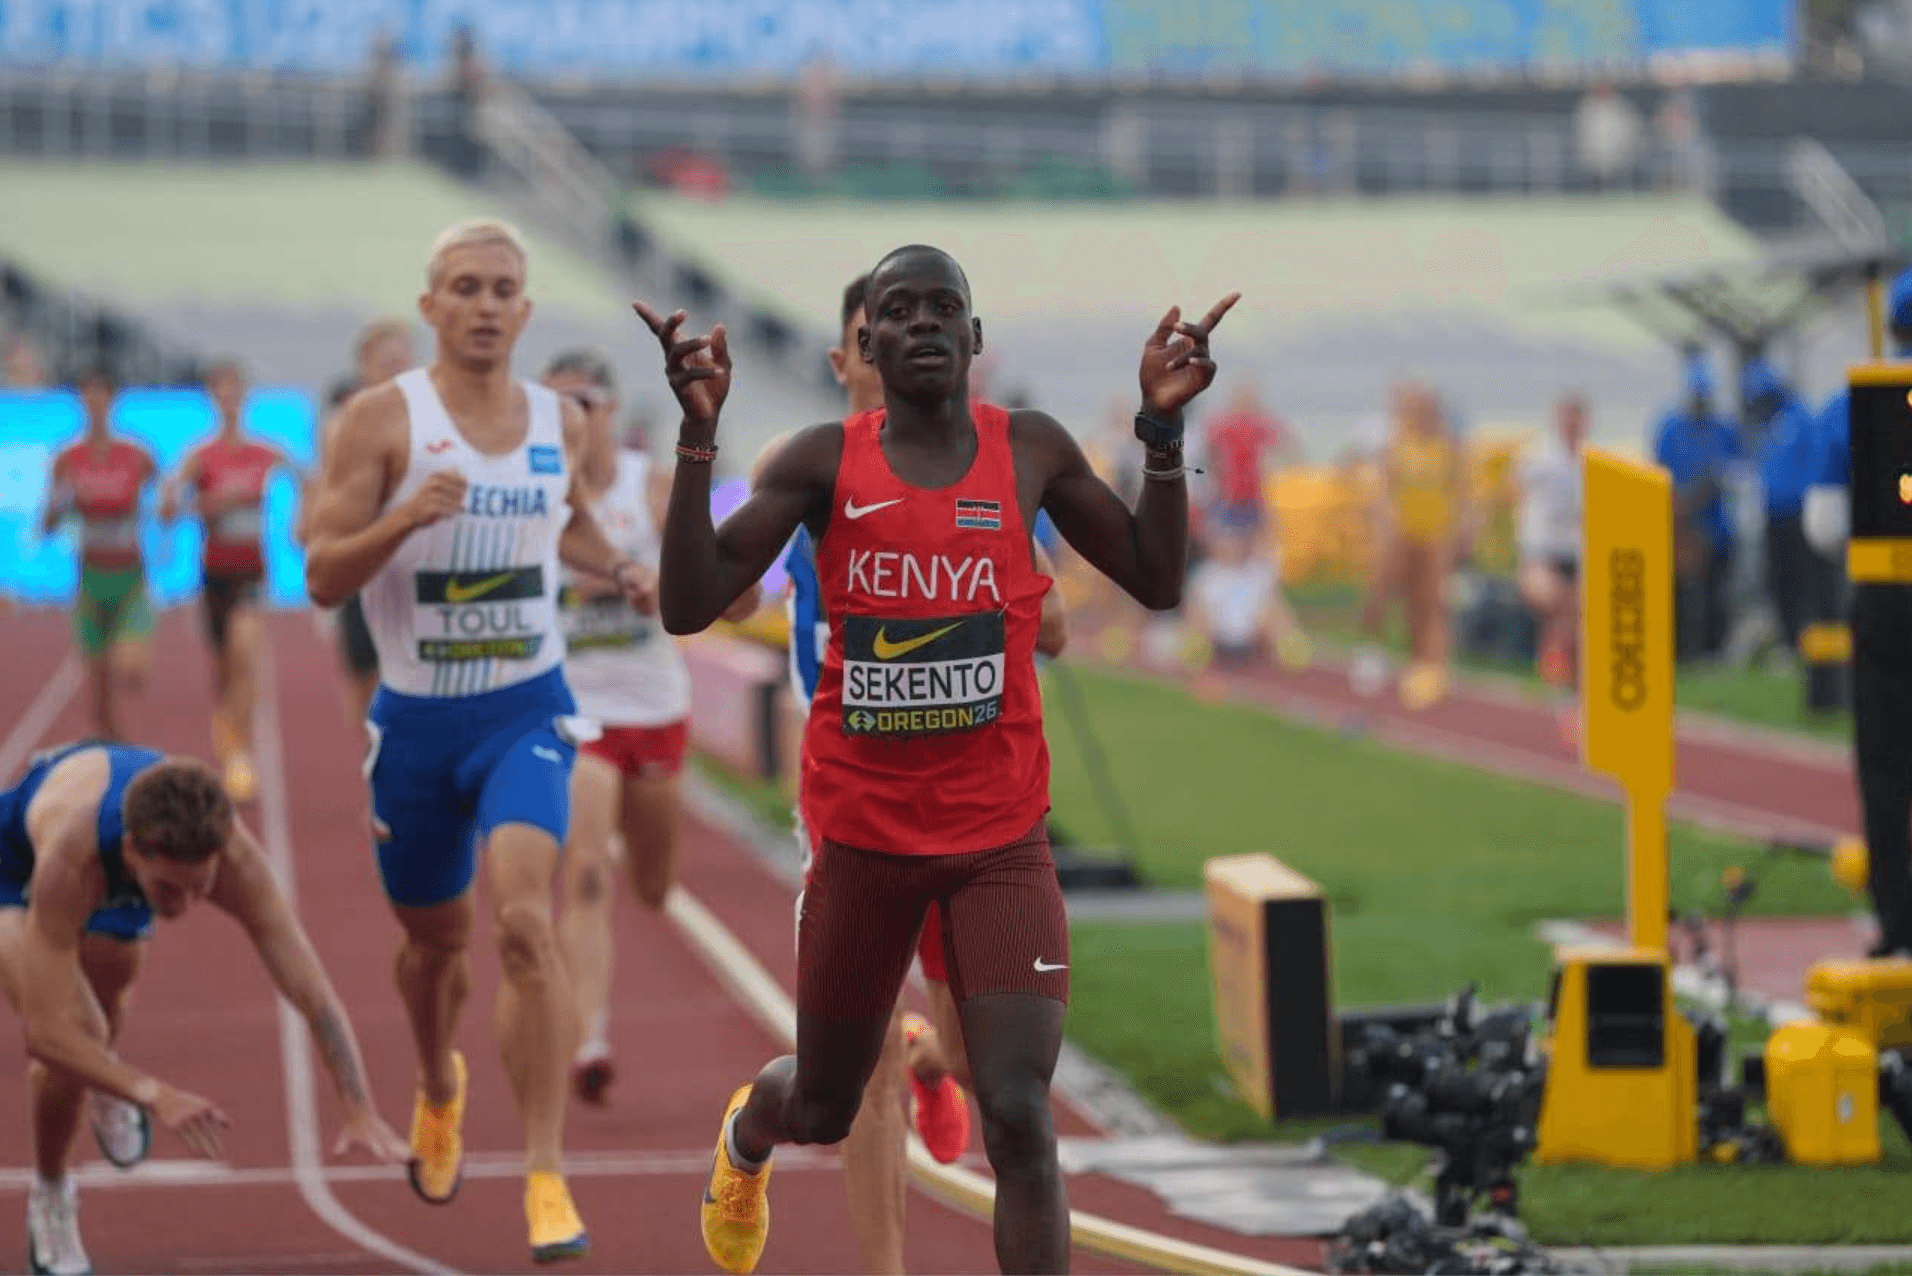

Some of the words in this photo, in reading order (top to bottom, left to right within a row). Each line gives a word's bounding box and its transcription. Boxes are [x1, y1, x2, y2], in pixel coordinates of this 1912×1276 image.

[847, 548, 1000, 602] KENYA
[436, 605, 532, 635] TOUL
[849, 660, 996, 702] SEKENTO
[876, 701, 998, 732] OREGON26
